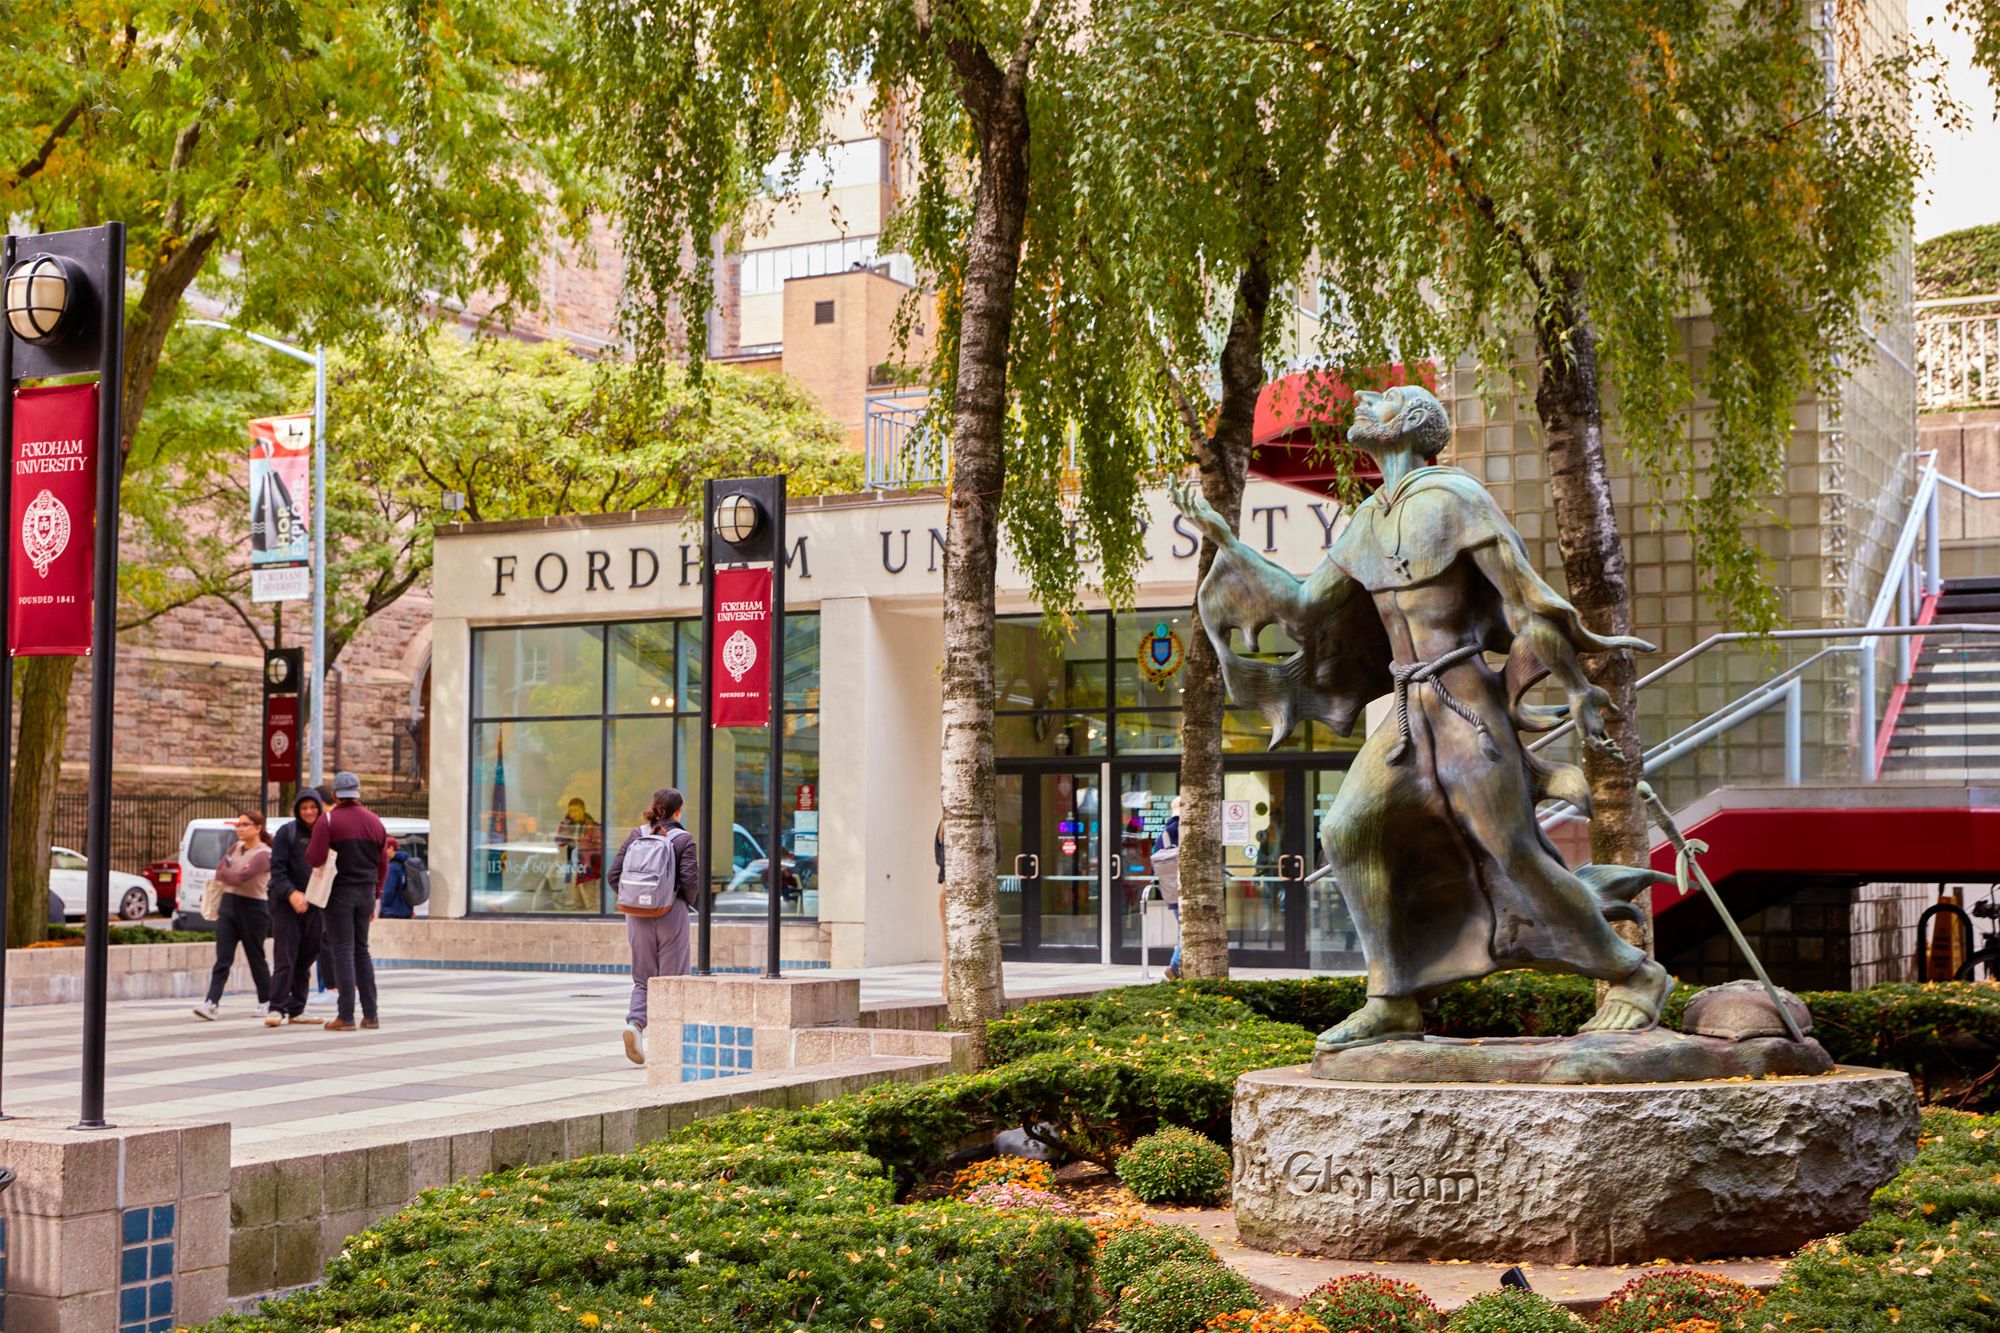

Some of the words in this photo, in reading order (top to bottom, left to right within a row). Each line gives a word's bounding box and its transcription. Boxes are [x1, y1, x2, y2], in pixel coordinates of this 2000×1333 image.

[21, 440, 83, 458] FORDHAM
[16, 457, 88, 475] UNIVERSITY
[492, 535, 811, 597] FORDHM
[880, 503, 1342, 574] UNESTY
[18, 596, 54, 605] FOUNDED
[56, 595, 75, 604] 1841
[721, 601, 763, 612] FORDHAM
[717, 611, 767, 622] UNIVERSITY
[1143, 824, 1165, 832] INSPEC
[487, 860, 502, 874] 113
[1283, 1150, 1480, 1202] Gloriam
